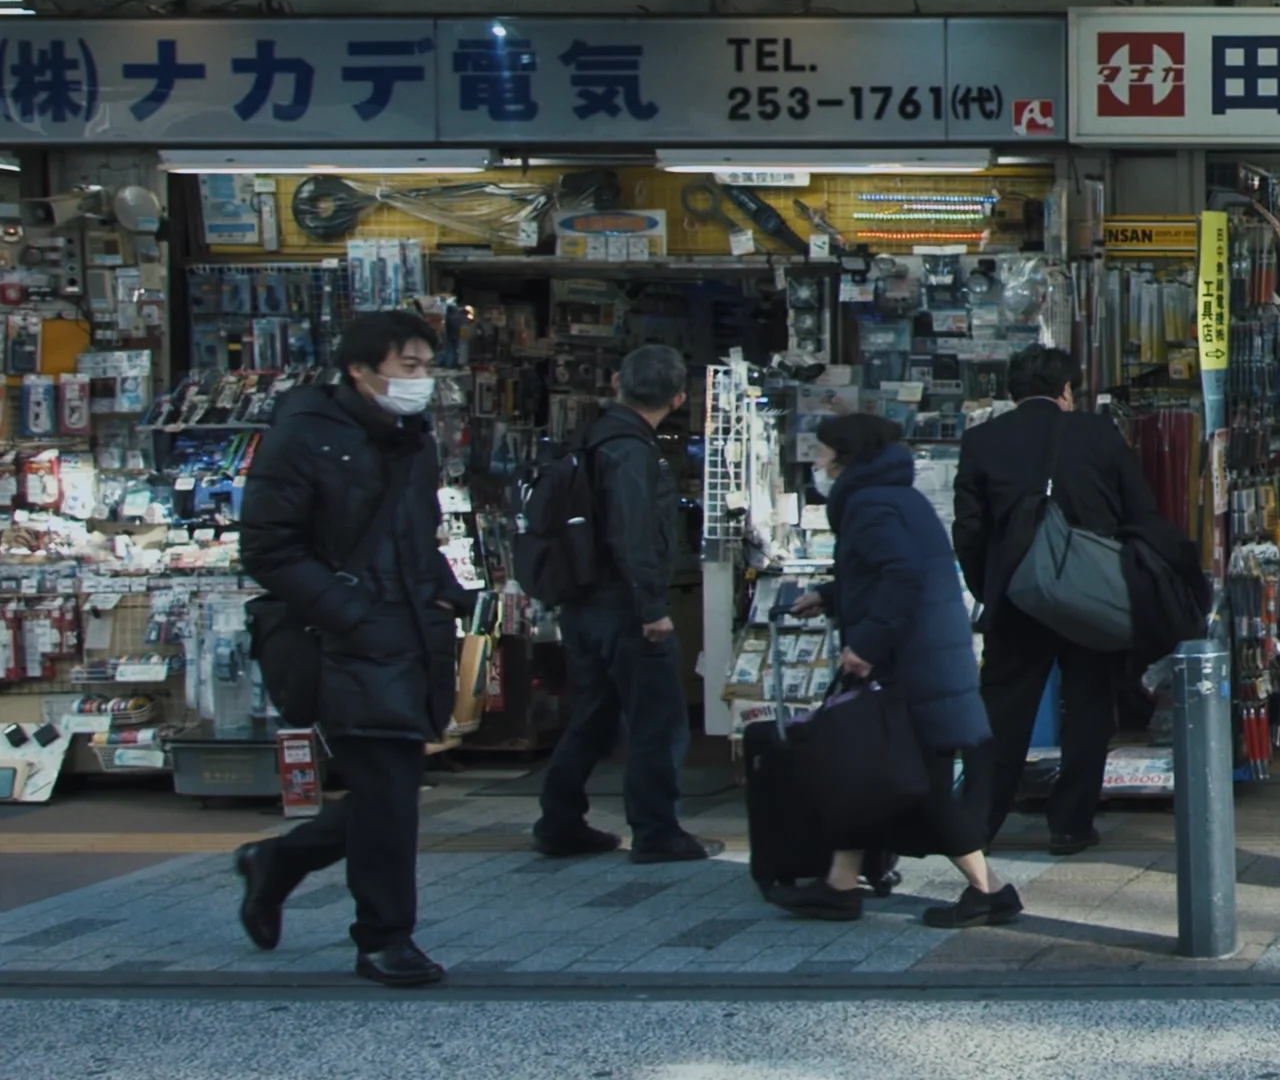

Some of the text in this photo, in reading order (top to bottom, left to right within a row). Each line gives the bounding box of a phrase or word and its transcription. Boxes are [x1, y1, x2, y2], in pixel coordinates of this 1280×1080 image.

[727, 38, 818, 73] TEL.
[1097, 65, 1184, 83] タナカ
